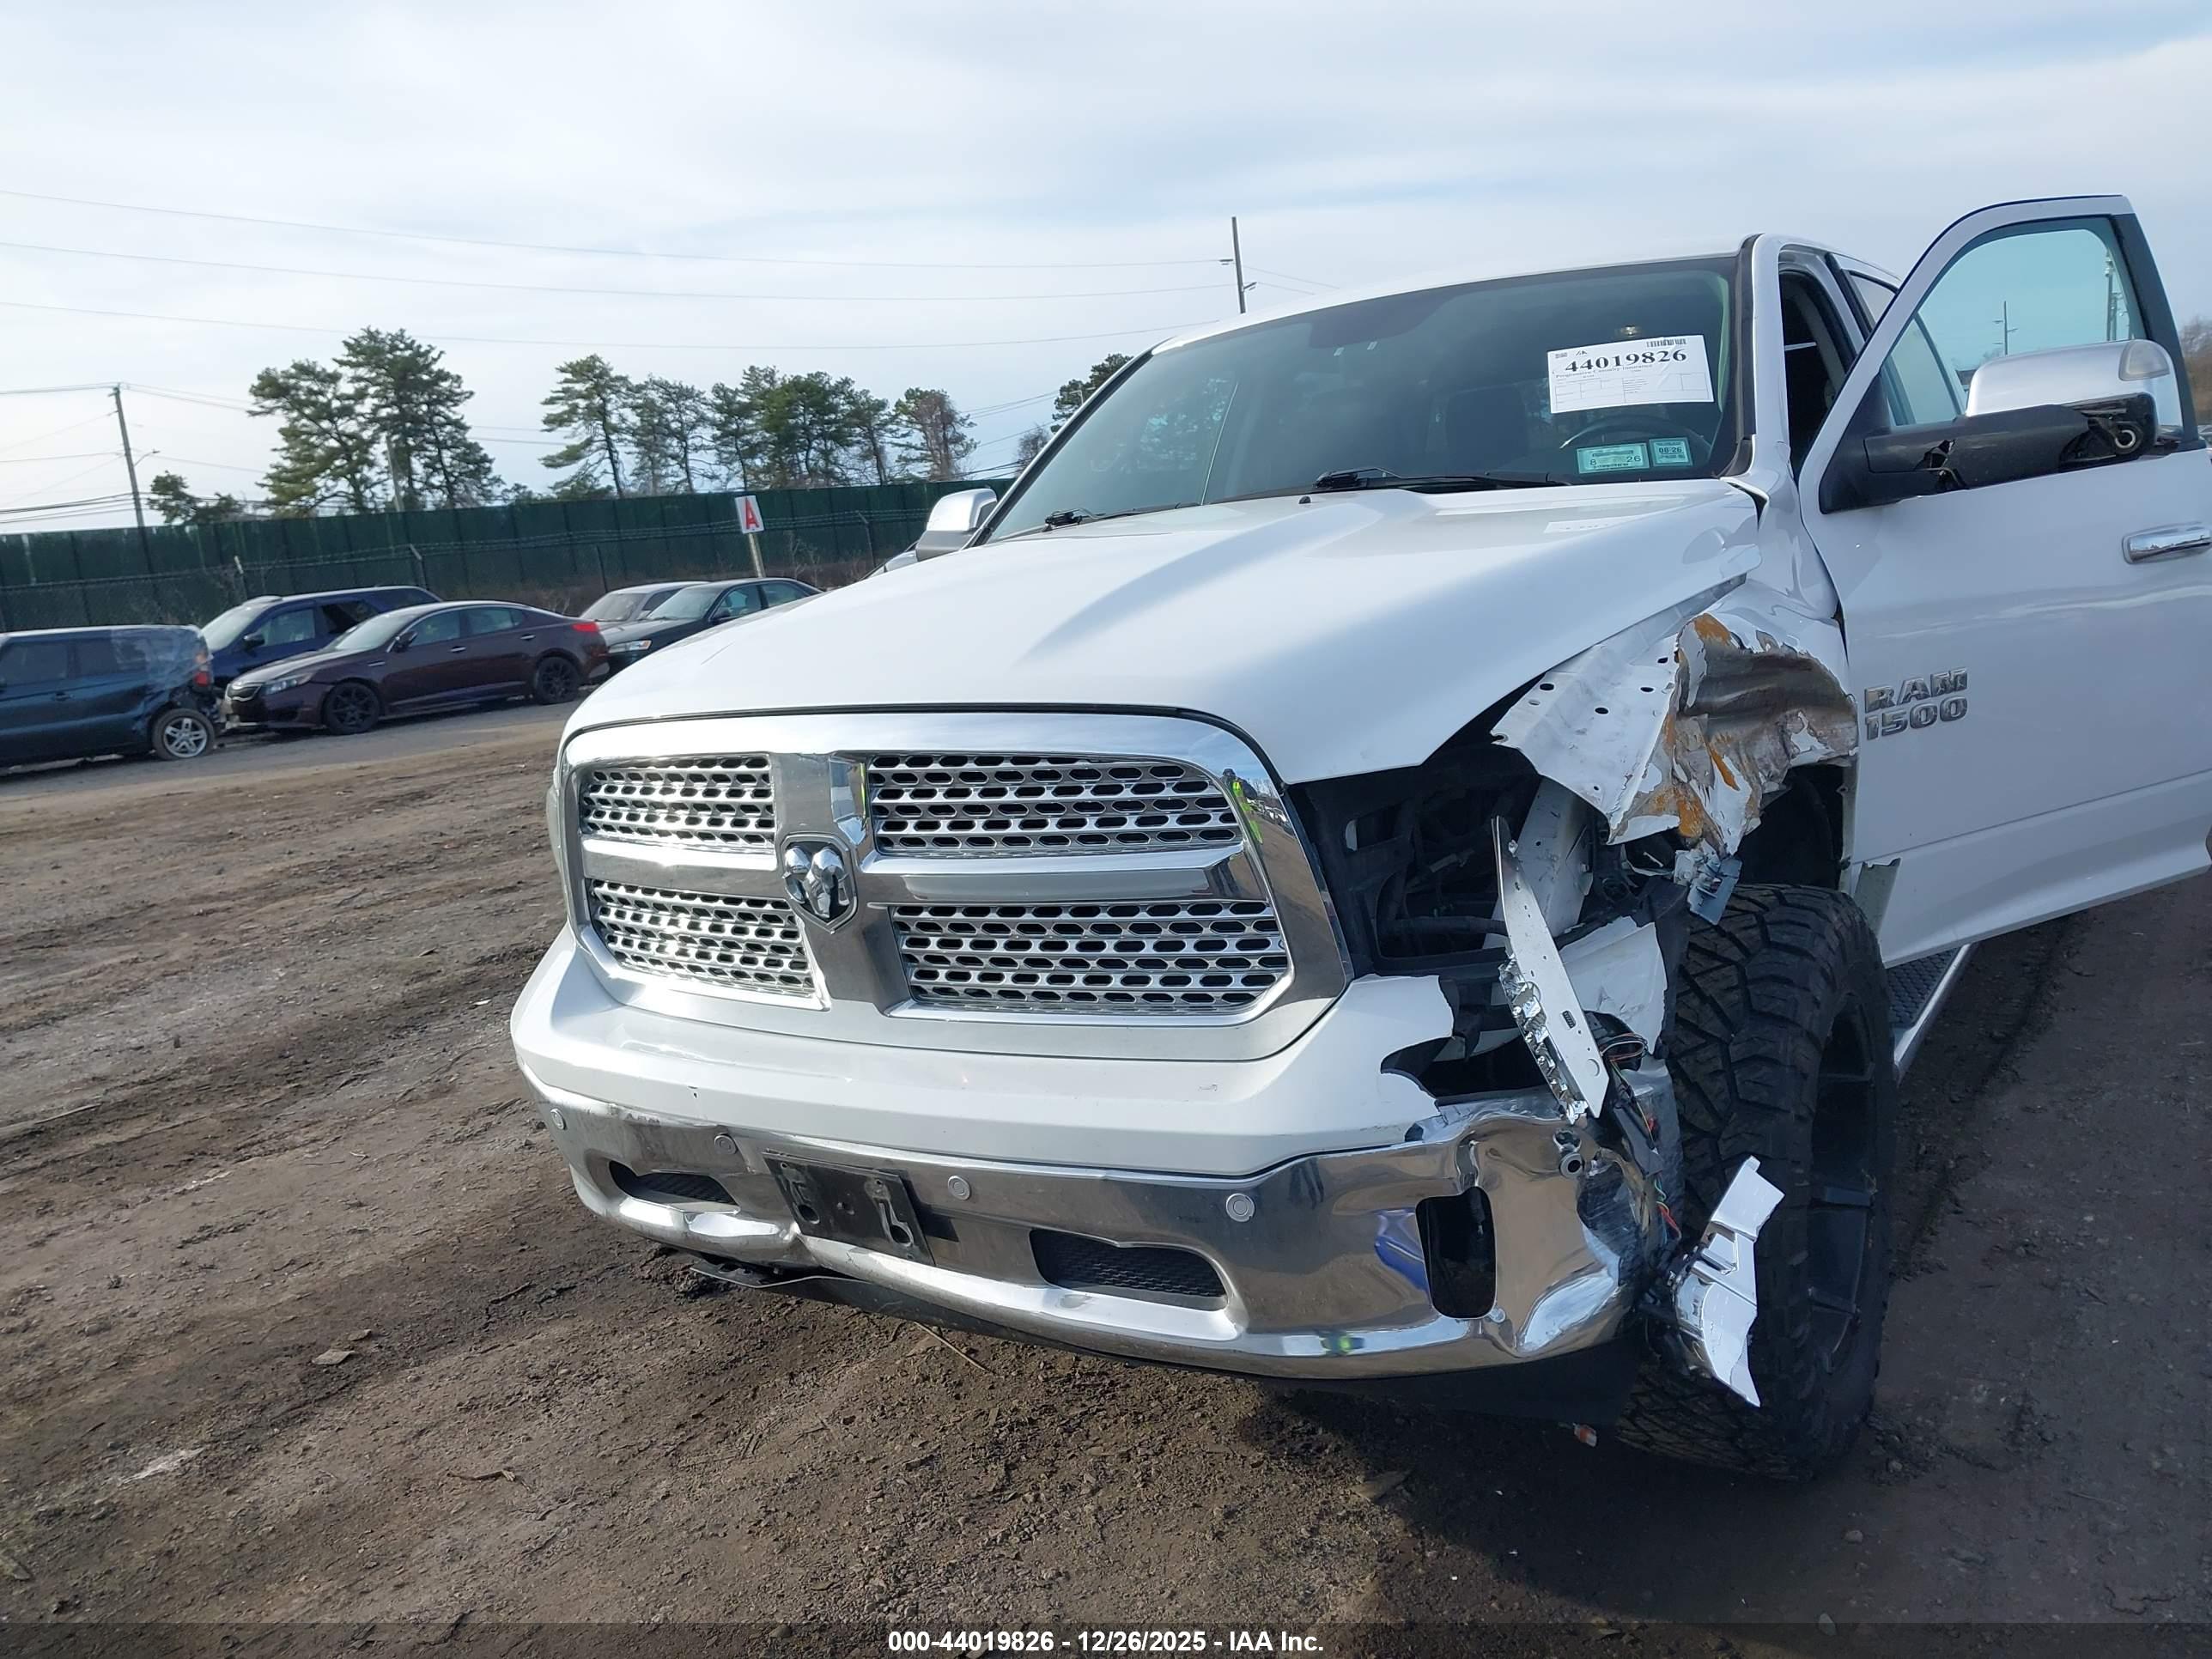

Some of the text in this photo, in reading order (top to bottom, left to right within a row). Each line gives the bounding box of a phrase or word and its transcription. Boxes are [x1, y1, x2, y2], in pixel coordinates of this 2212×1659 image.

[1565, 349, 1687, 372] 44019826
[1864, 667, 1968, 714] RAM
[1865, 696, 1968, 741] 1500
